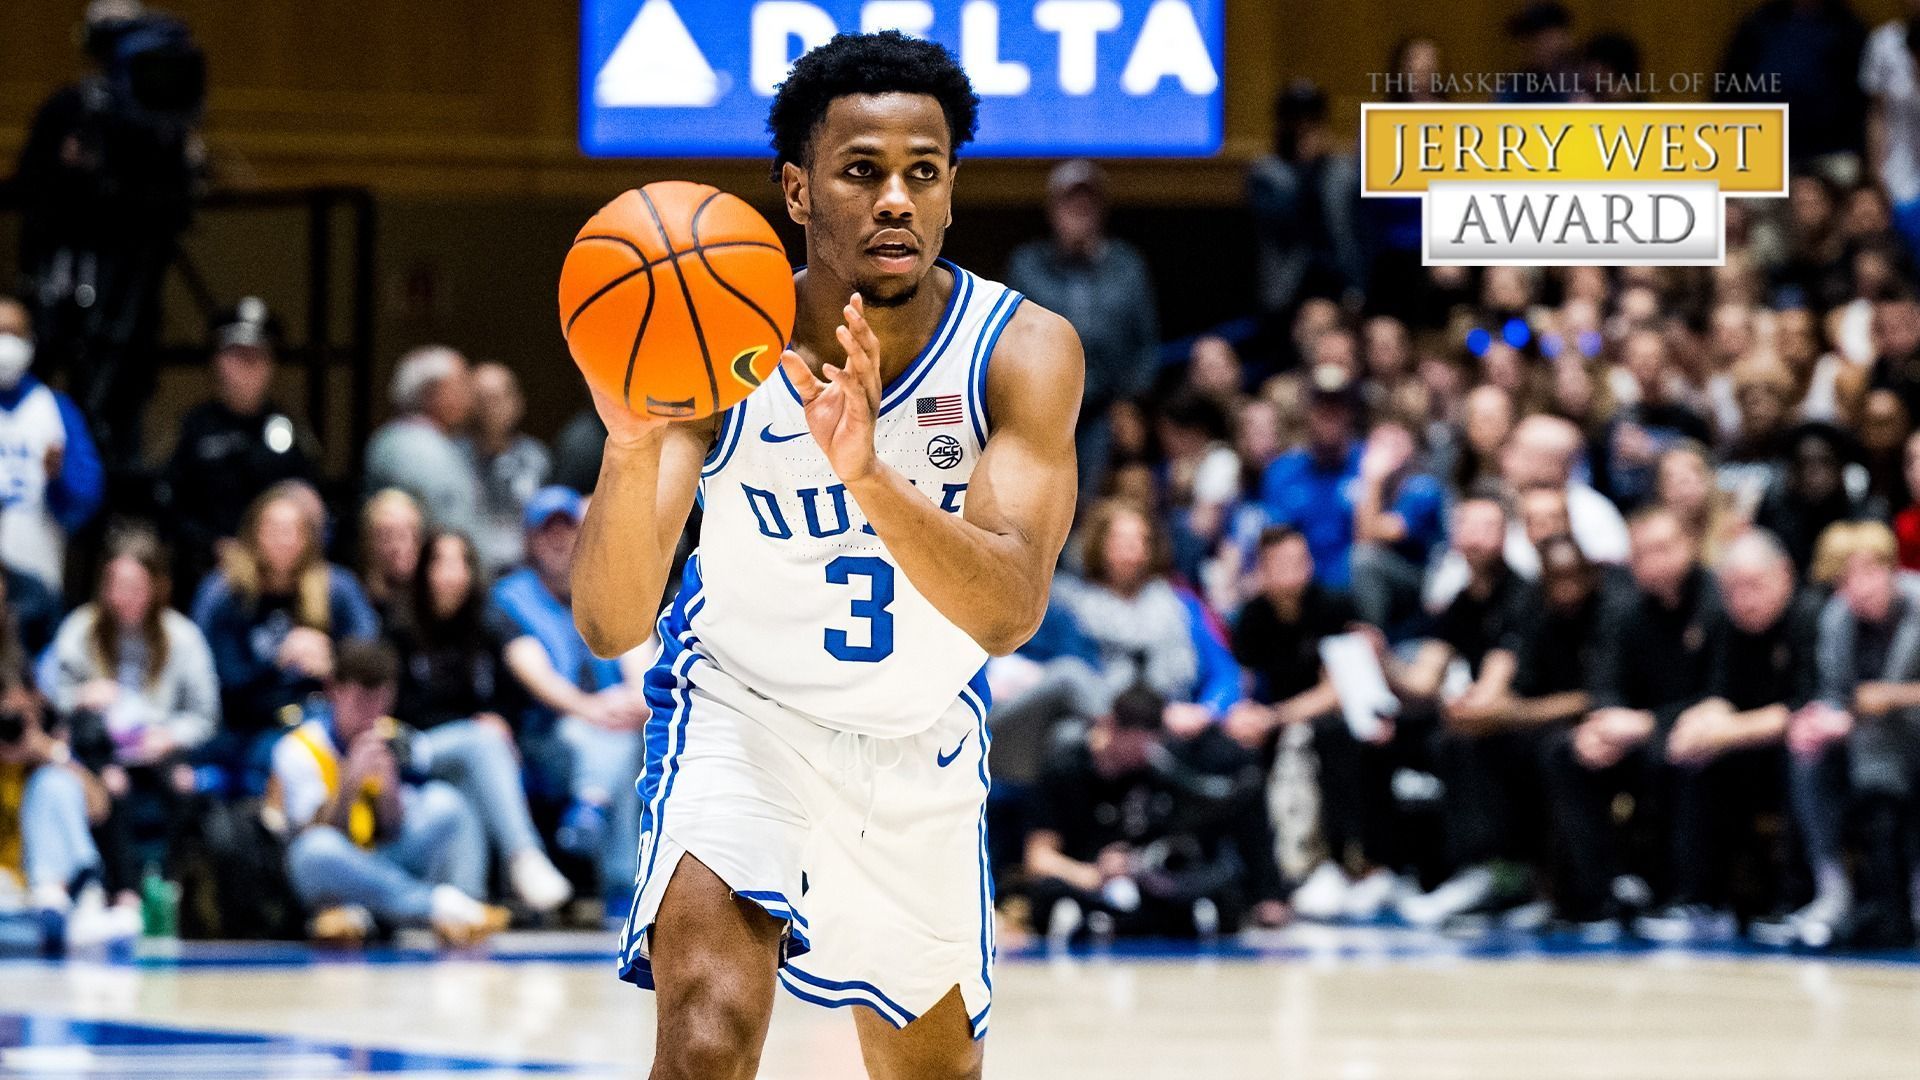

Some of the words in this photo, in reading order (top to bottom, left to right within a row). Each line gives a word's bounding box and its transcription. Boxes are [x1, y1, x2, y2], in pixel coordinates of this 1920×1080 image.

[931, 445, 960, 457] ACC
[740, 479, 968, 539] DUE
[824, 556, 895, 663] 3
